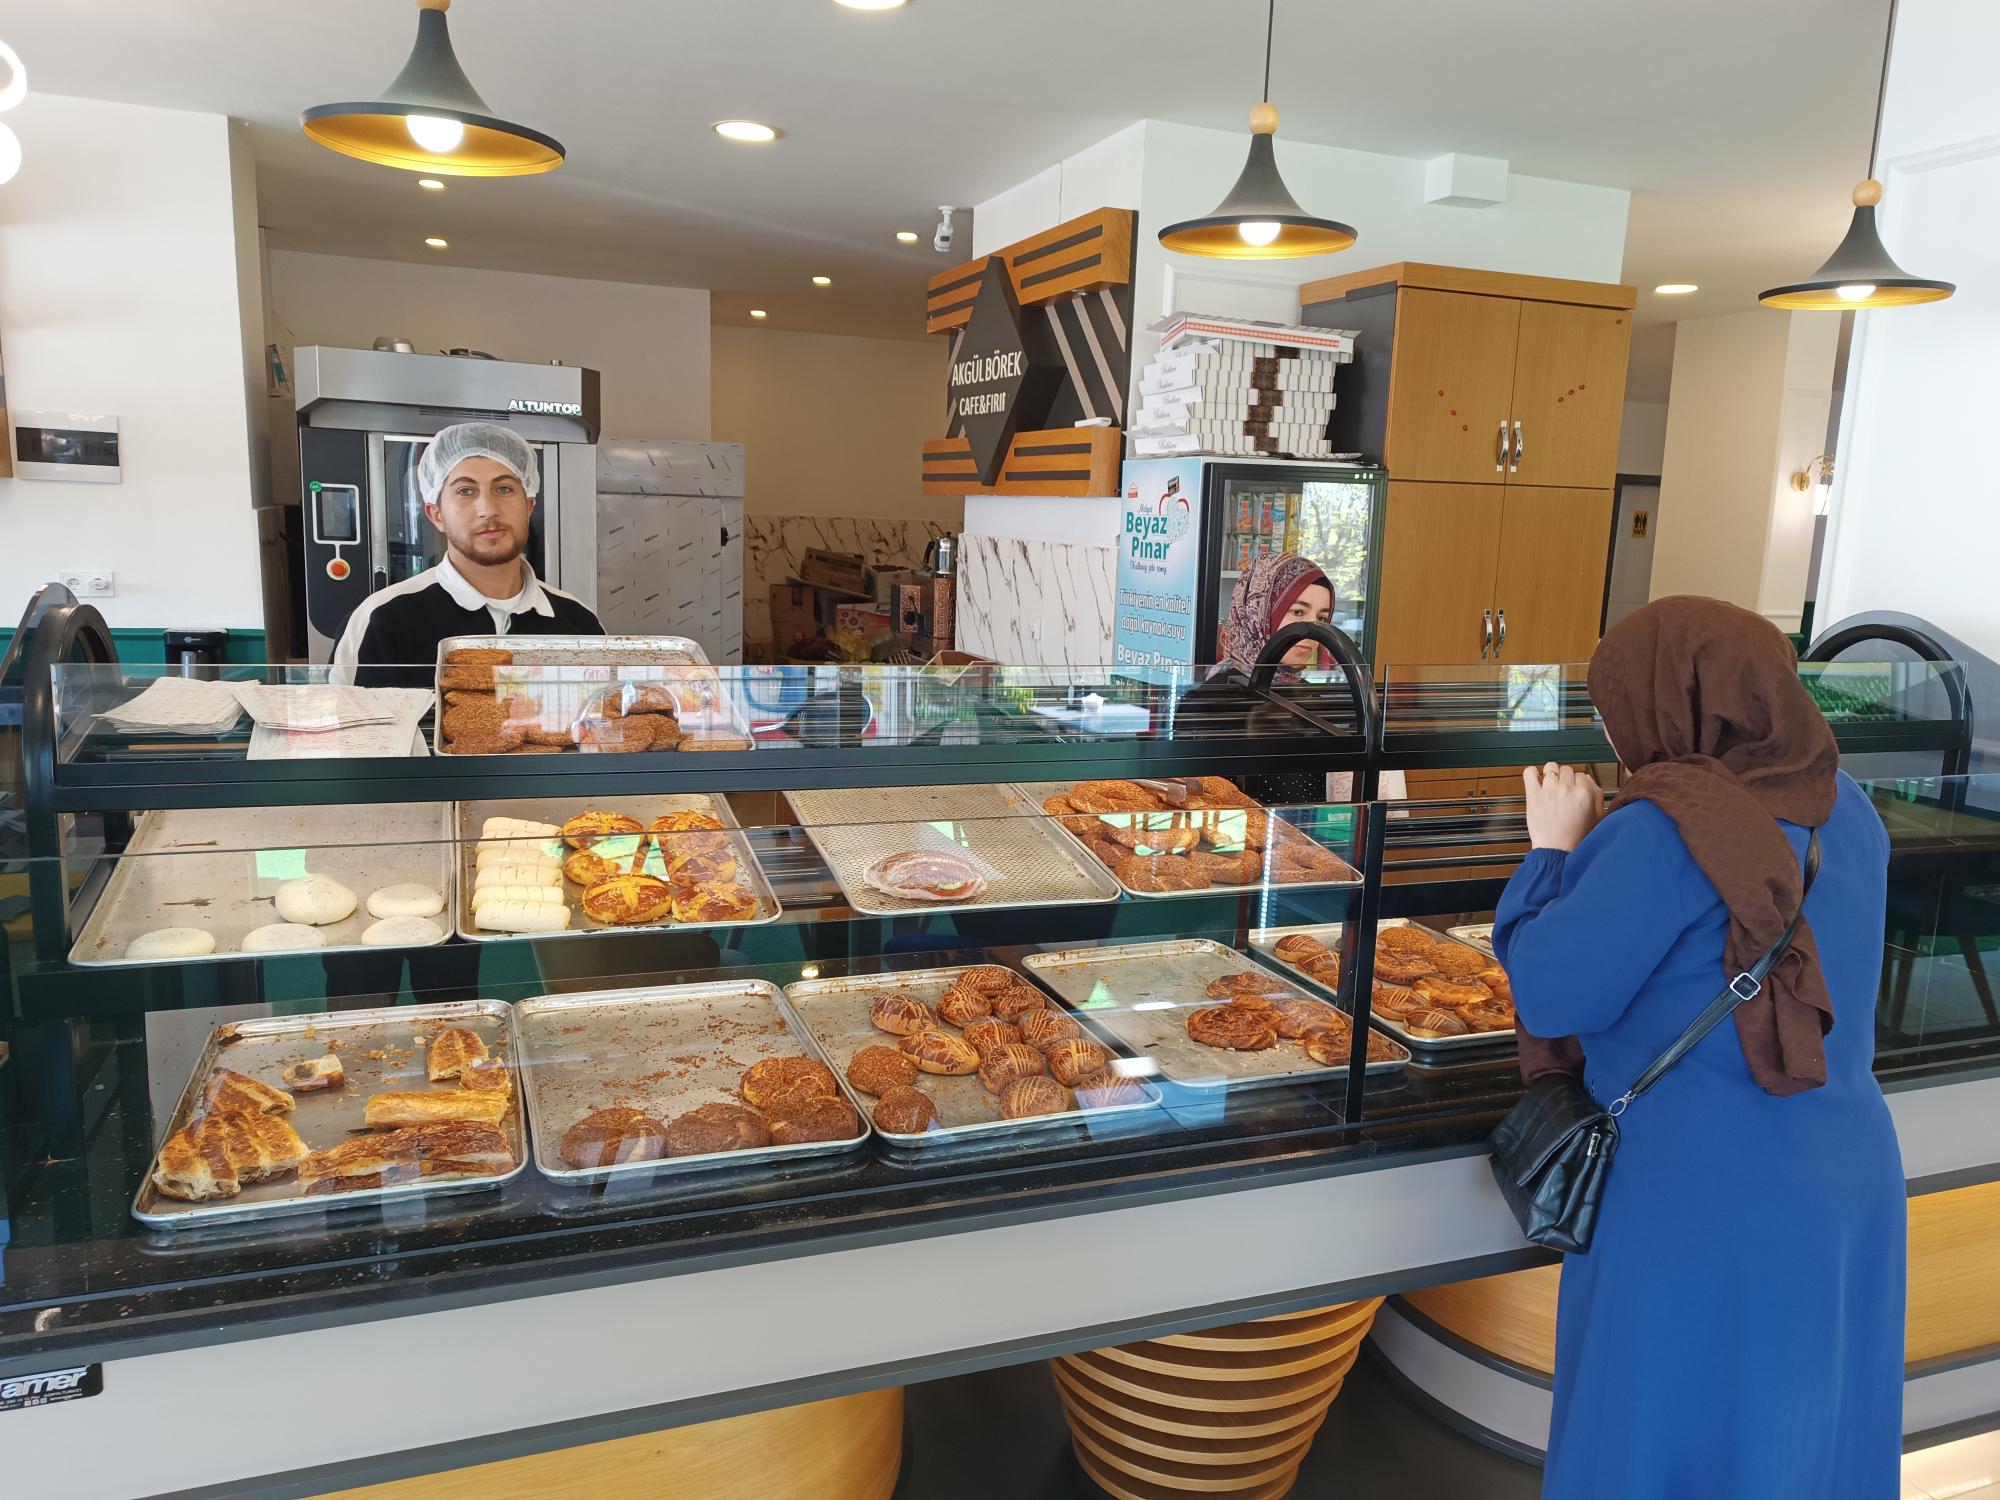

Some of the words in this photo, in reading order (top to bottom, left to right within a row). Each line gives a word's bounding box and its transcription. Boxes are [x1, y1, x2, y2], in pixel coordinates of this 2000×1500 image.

[951, 354, 984, 387] AKGÜL
[985, 349, 1022, 381] BÖREK
[507, 399, 582, 415] ALTUNTOP
[1126, 511, 1168, 540] Beyaz
[1155, 596, 1165, 611] en
[1165, 593, 1191, 615] kaliteli
[1121, 613, 1140, 635] doğal
[1141, 614, 1167, 638] kaynak
[1167, 623, 1187, 644] suyu
[1117, 643, 1151, 669] Beyaz
[0, 1366, 88, 1399] amer
